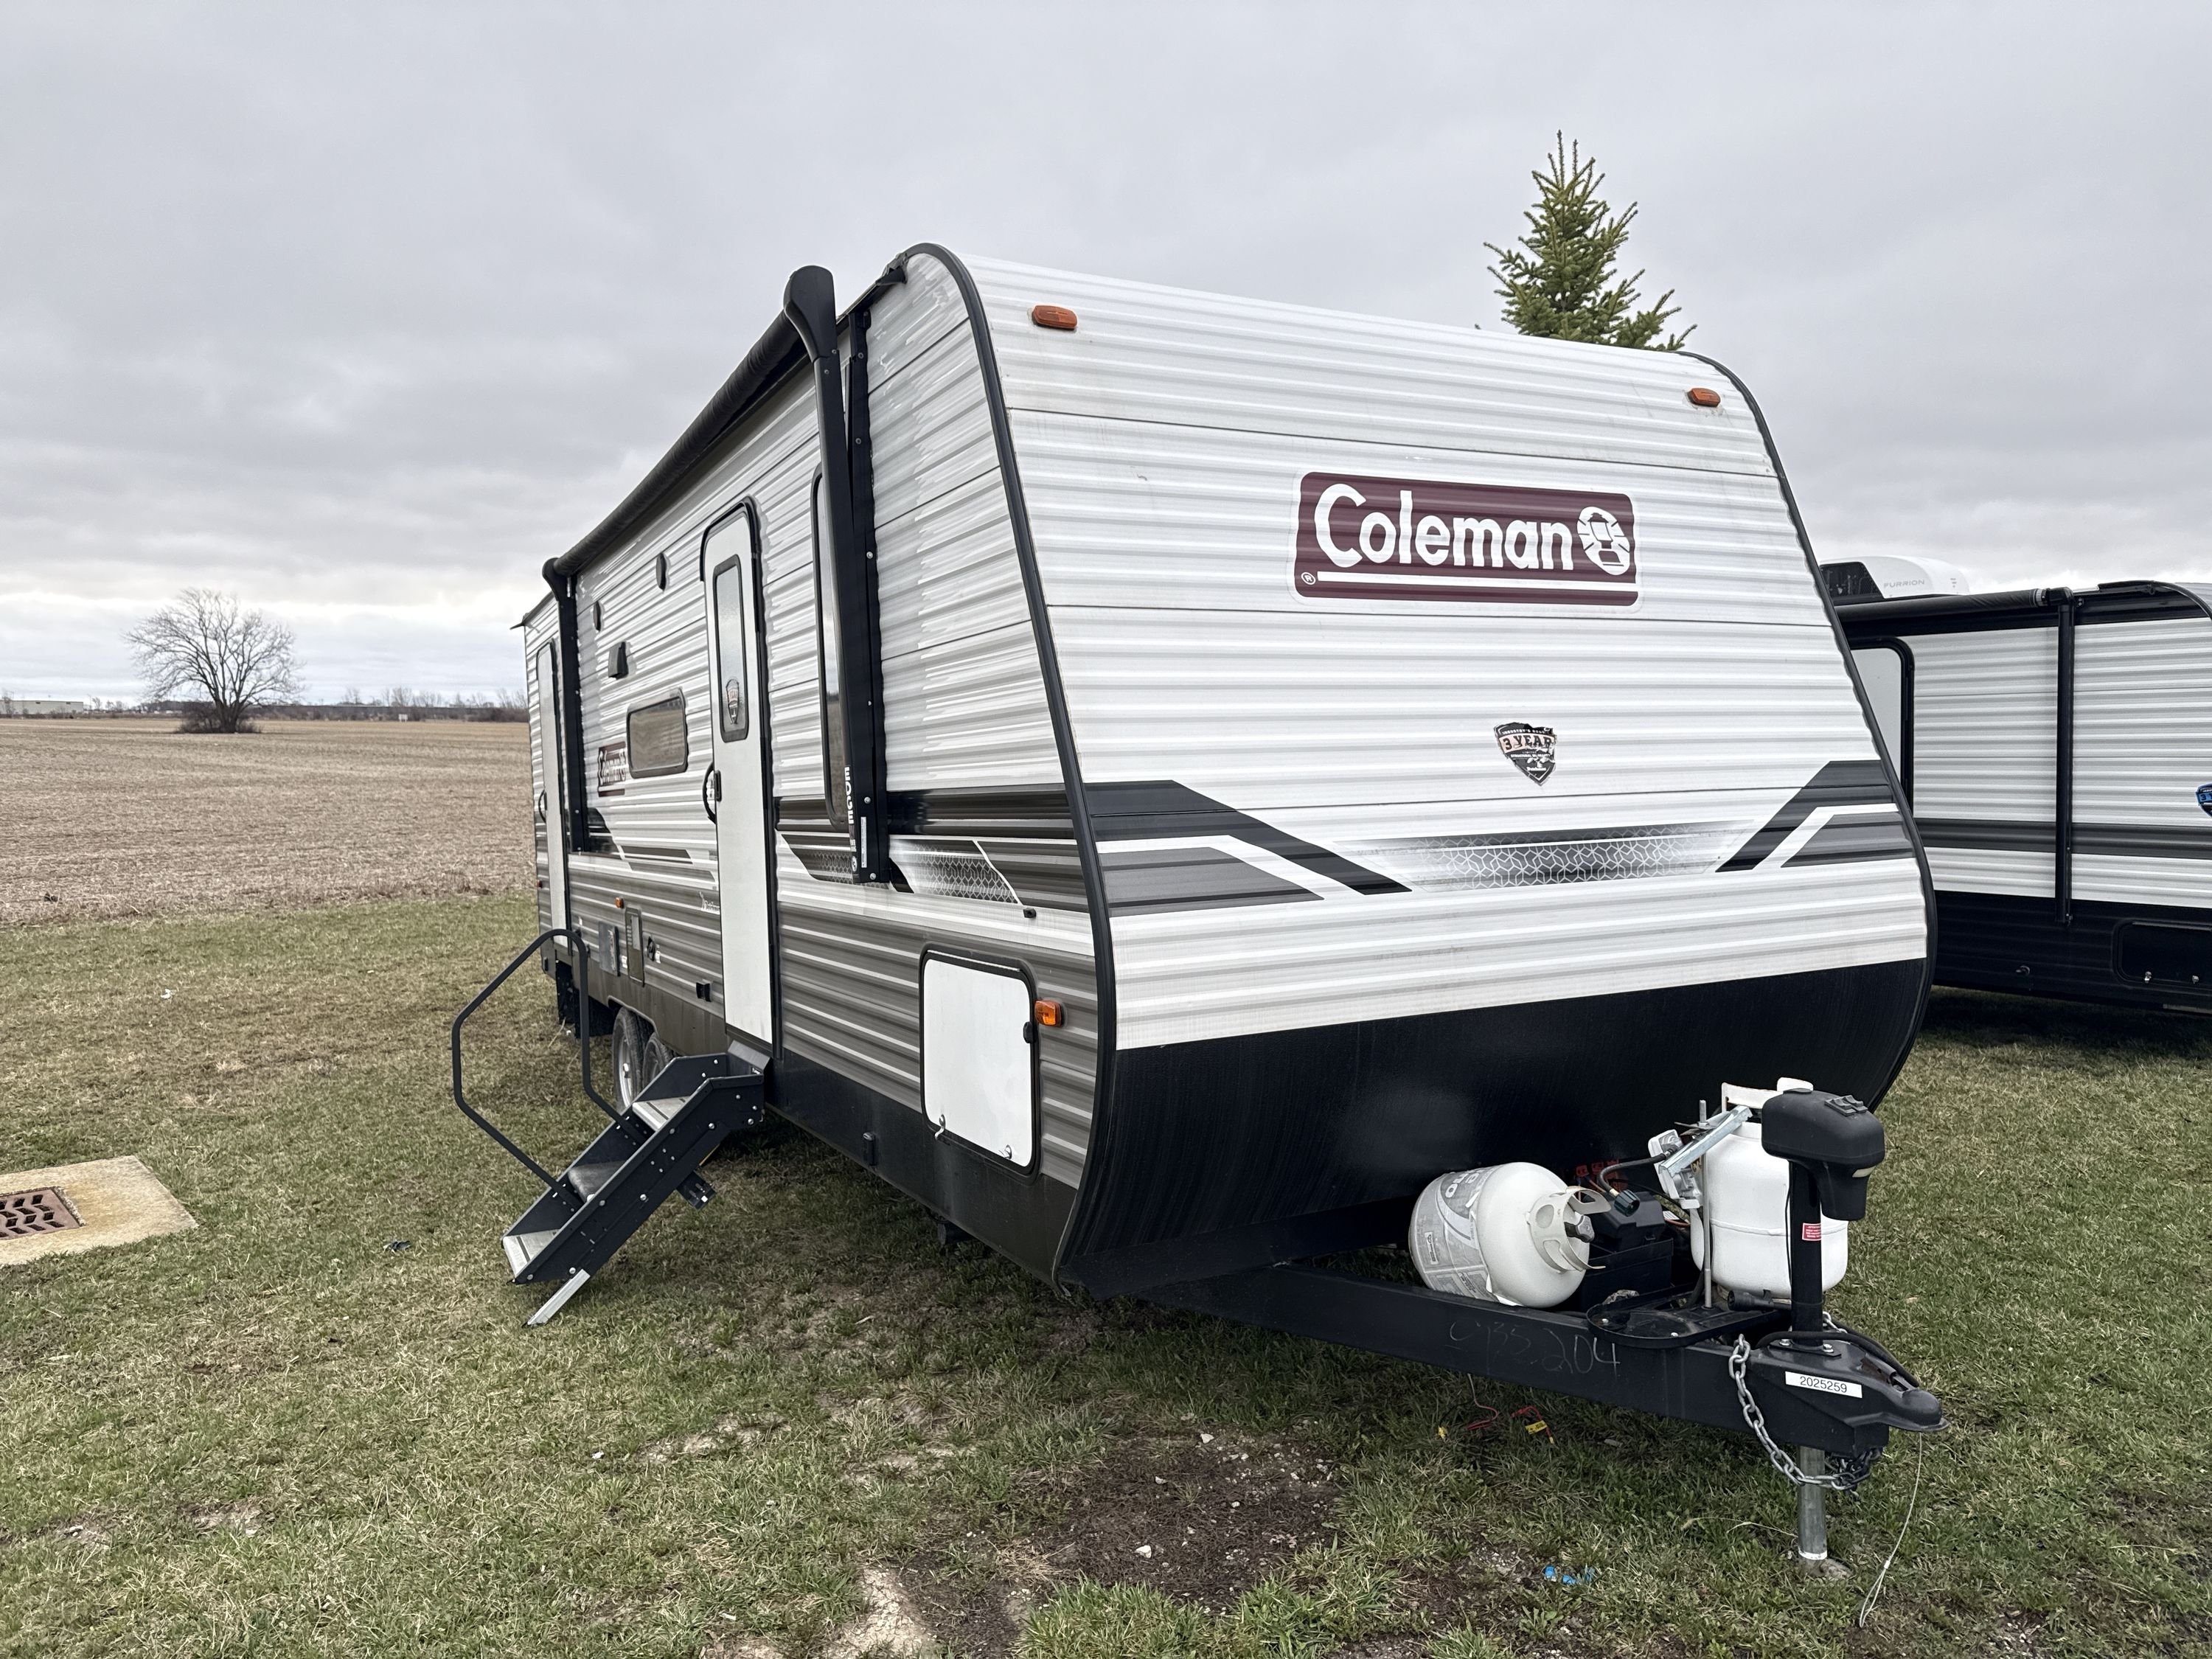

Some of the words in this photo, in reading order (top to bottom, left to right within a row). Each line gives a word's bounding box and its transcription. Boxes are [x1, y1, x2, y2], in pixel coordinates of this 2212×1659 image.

[1314, 483, 1573, 570] Coleman
[1884, 580, 1925, 588] FURRION
[1503, 737, 1512, 751] 3
[844, 766, 855, 824] EDGE
[1800, 1376, 1847, 1393] 2025259
